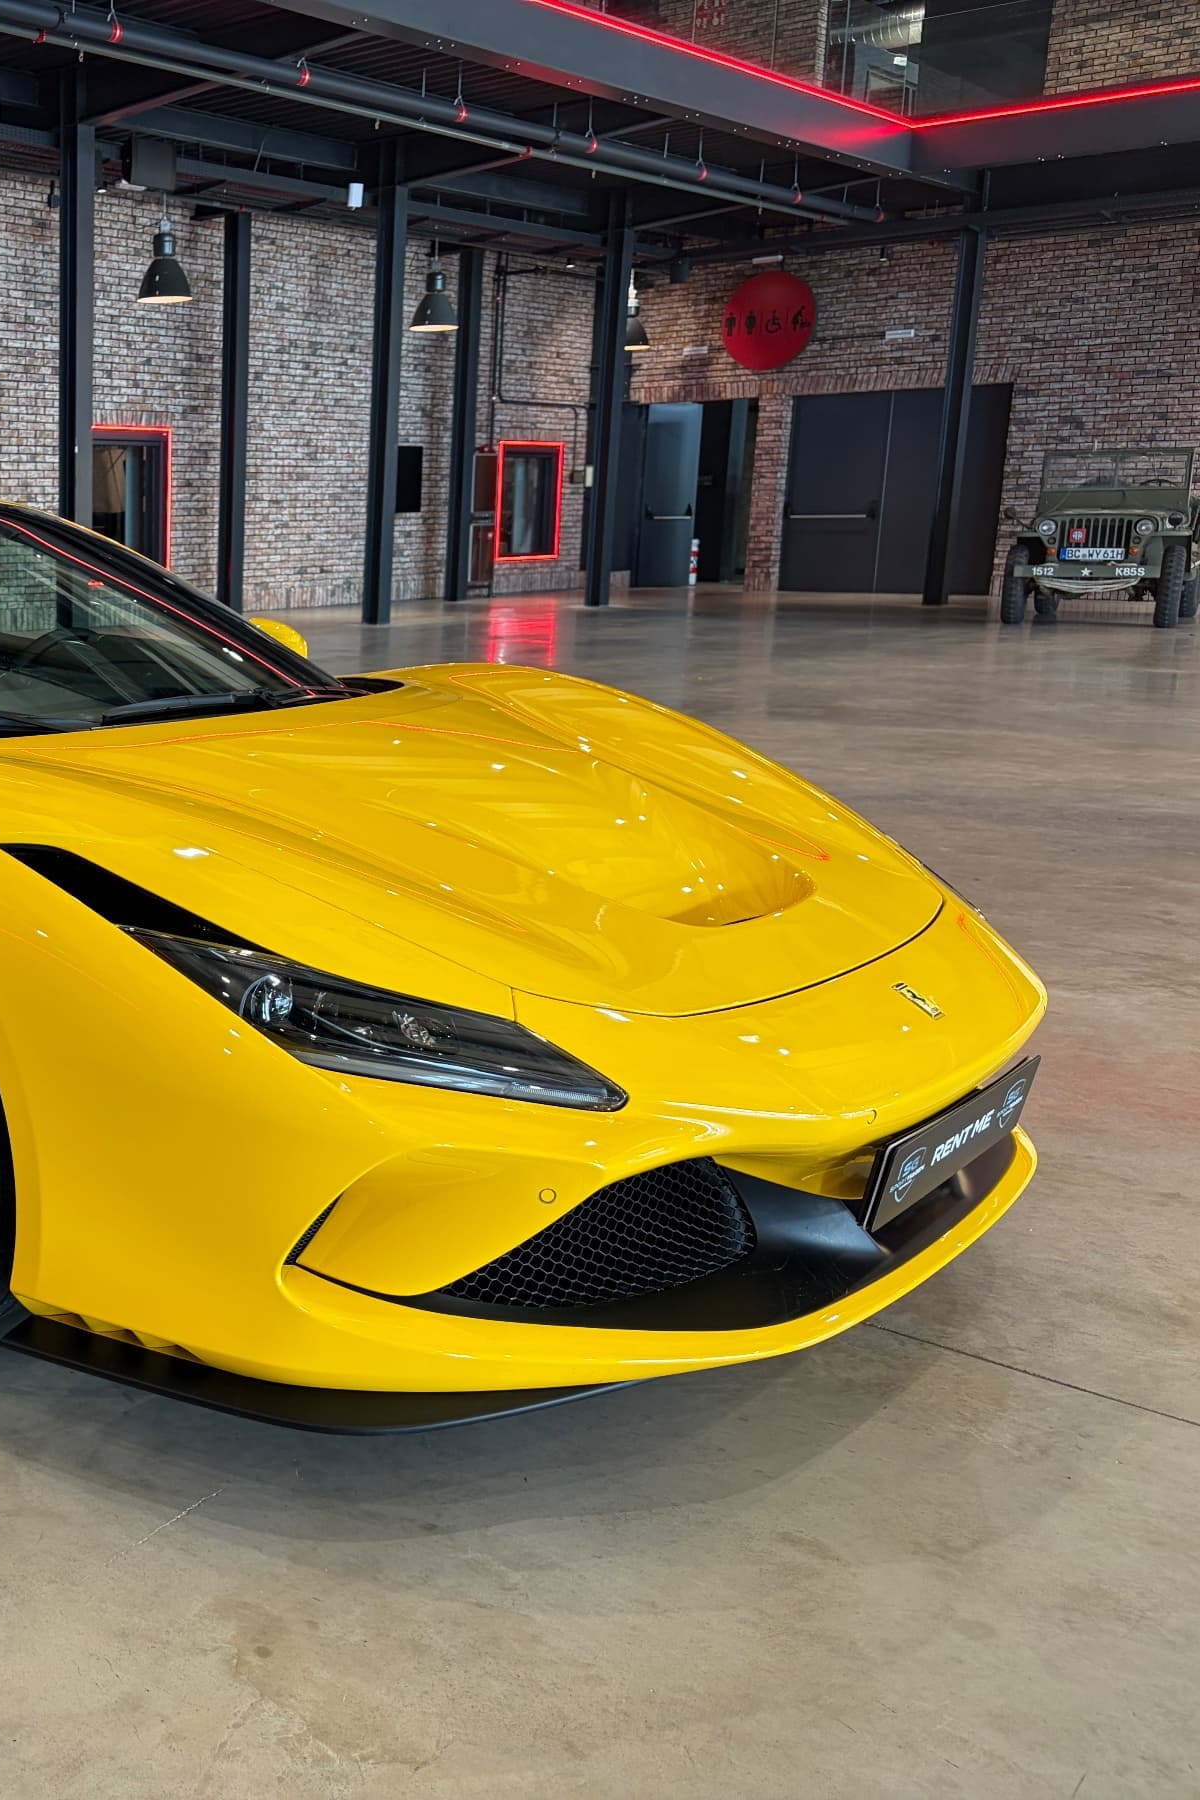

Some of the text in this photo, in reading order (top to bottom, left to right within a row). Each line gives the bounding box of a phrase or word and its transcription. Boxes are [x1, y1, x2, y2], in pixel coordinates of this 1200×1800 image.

[1031, 567, 1054, 576] 1512
[930, 1108, 995, 1167] RENT ME
